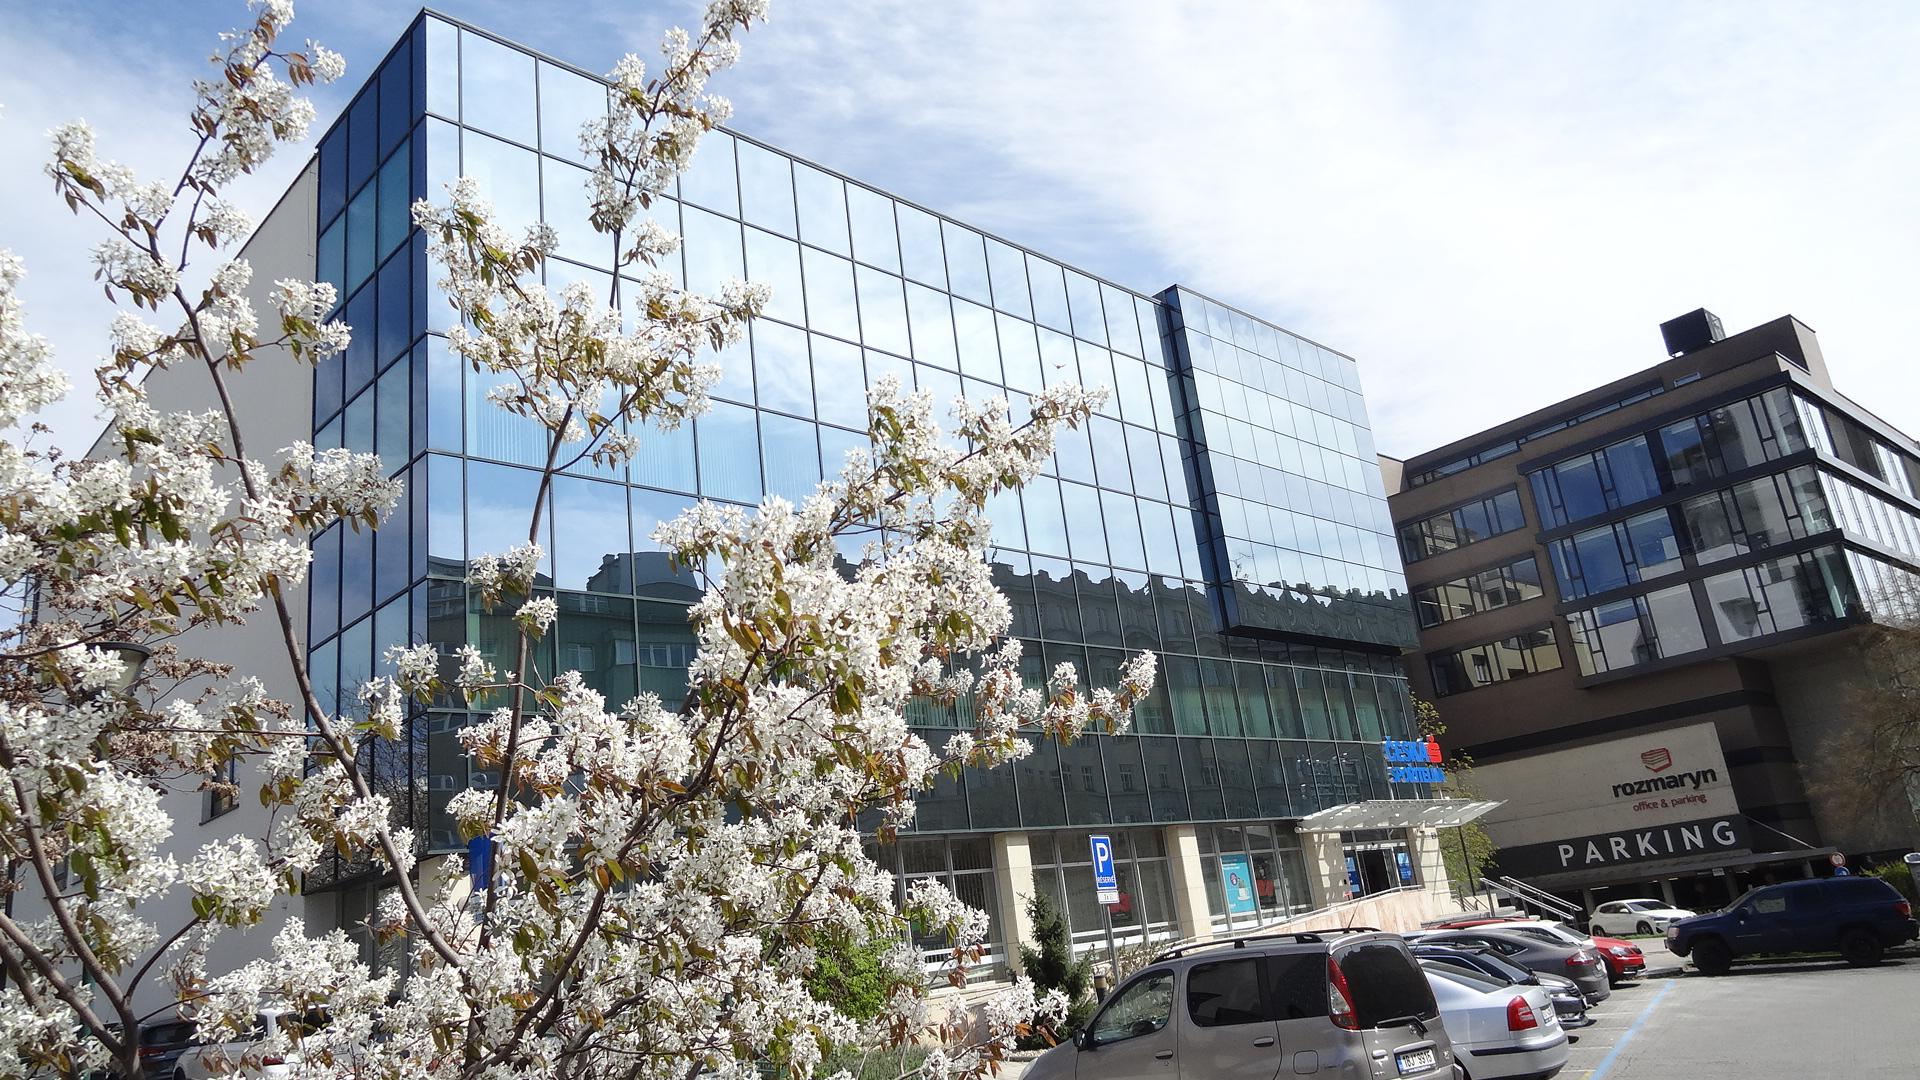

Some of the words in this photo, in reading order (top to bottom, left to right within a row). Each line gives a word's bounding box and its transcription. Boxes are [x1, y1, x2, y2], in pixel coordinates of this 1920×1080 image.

[1611, 768, 1718, 799] rozmaryn
[1632, 800, 1659, 812] office
[1660, 798, 1670, 809] &
[1671, 793, 1708, 808] parking
[1095, 842, 1109, 873] P
[1558, 821, 1737, 867] PARKING
